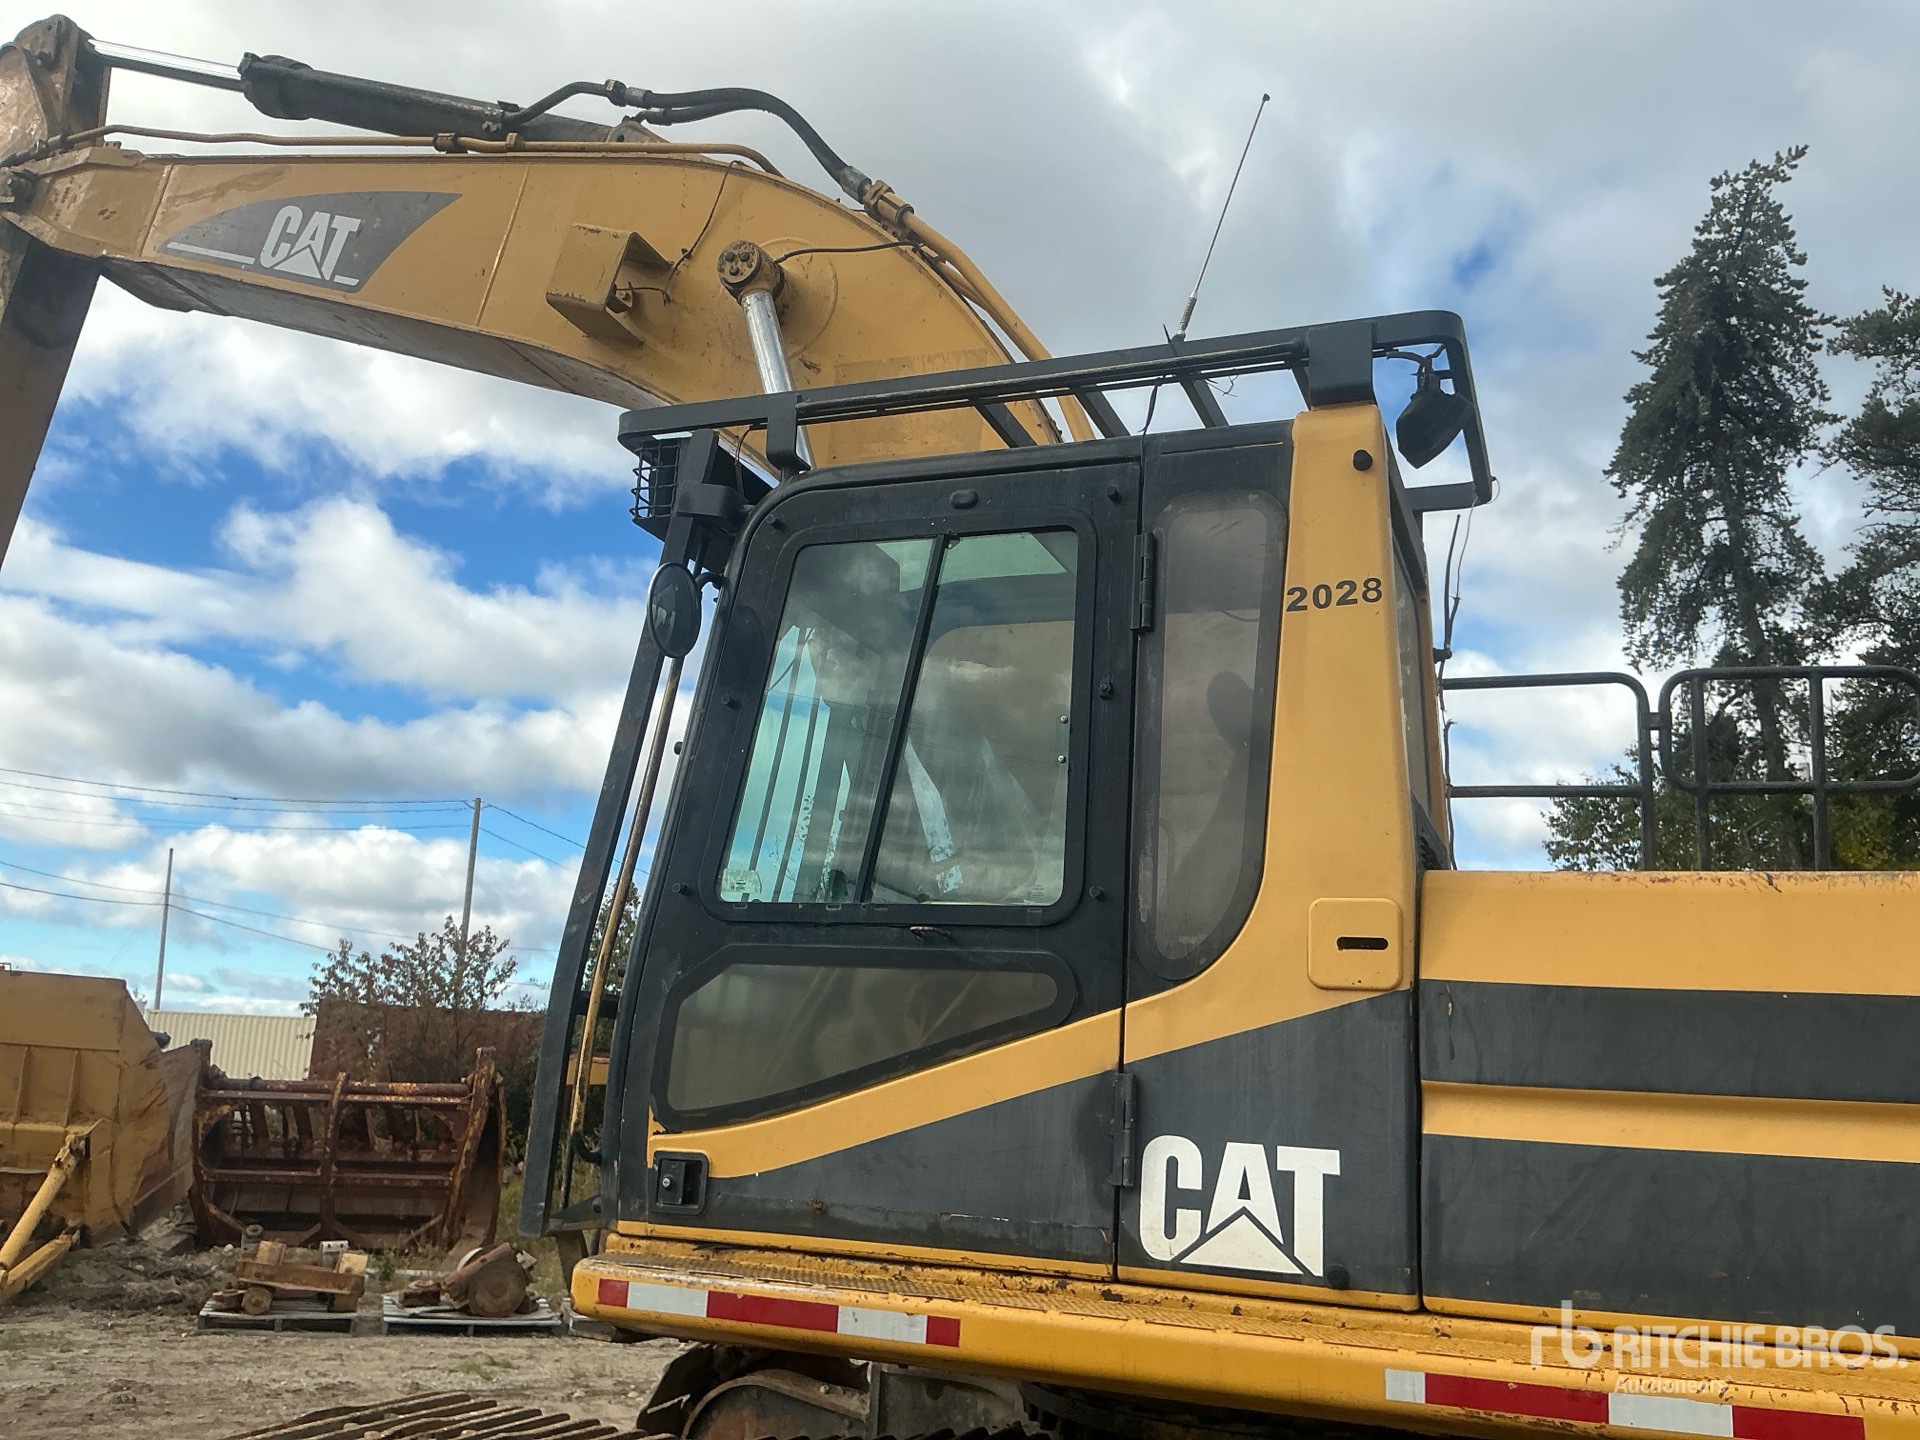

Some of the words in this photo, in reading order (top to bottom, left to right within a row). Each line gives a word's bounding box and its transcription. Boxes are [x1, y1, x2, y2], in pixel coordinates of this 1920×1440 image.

[260, 205, 361, 281] CAT
[1286, 577, 1383, 612] 2028
[1139, 1135, 1341, 1277] CAT
